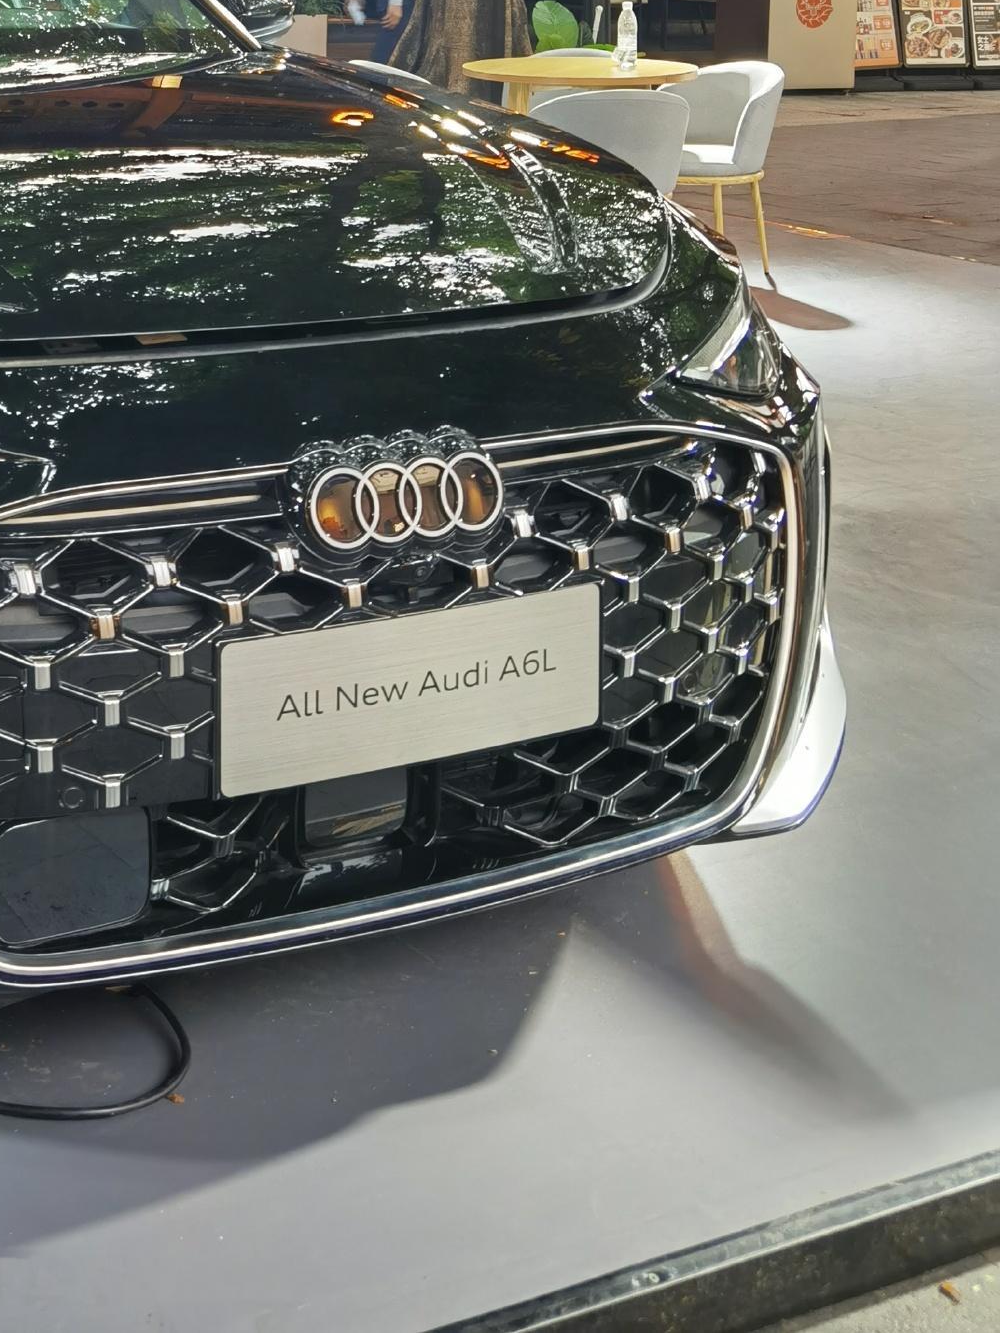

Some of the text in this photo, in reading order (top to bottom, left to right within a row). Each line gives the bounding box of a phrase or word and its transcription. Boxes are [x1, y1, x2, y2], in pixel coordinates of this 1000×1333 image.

[276, 648, 557, 721] All New Audi A6L
